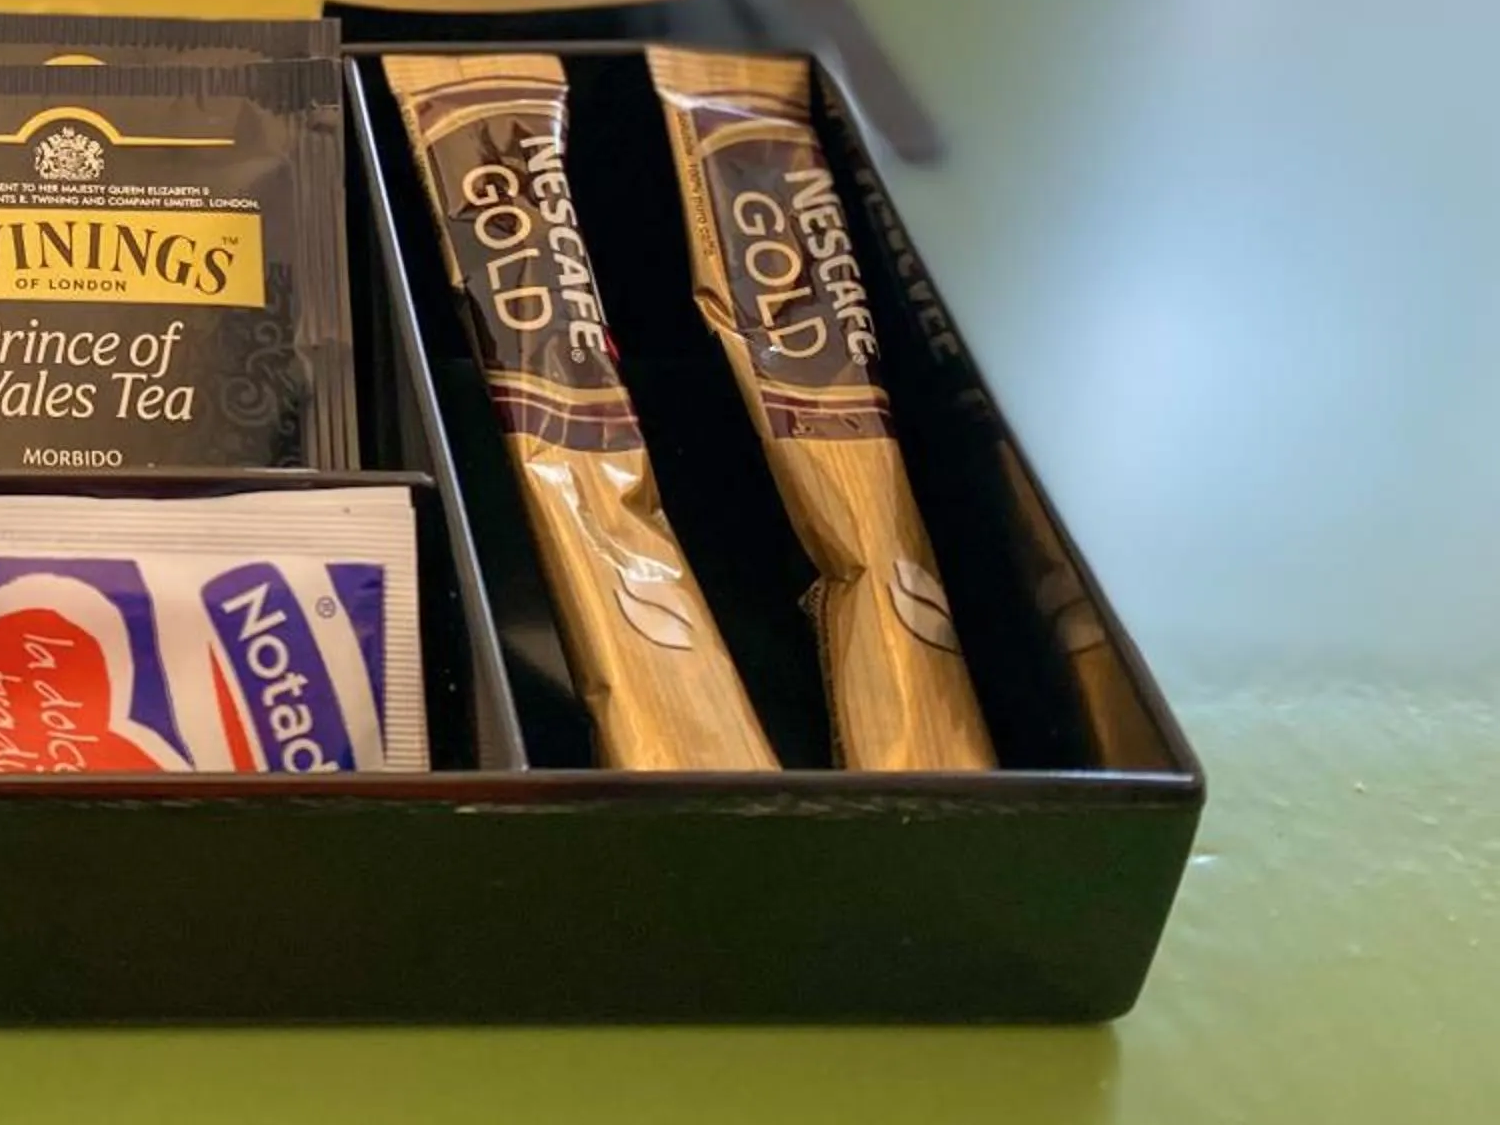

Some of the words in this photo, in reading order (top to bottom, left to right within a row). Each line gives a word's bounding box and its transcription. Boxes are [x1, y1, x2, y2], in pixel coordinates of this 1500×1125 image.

[22, 183, 35, 192] TO
[39, 183, 58, 193] HER
[61, 184, 105, 194] MAJESTY
[108, 185, 145, 195] QUEEN
[148, 186, 200, 196] ELIZABETH
[31, 195, 79, 206] TWINING
[81, 196, 105, 206] AND
[108, 196, 161, 207] COMPANY
[461, 164, 553, 331] GOLD
[15, 277, 41, 290] OF
[49, 278, 127, 292] LONDON
[733, 191, 828, 359] GOLD
[129, 320, 184, 378] of
[111, 372, 195, 421] Tea
[22, 448, 123, 467] MORBIDO
[22, 633, 75, 669] la
